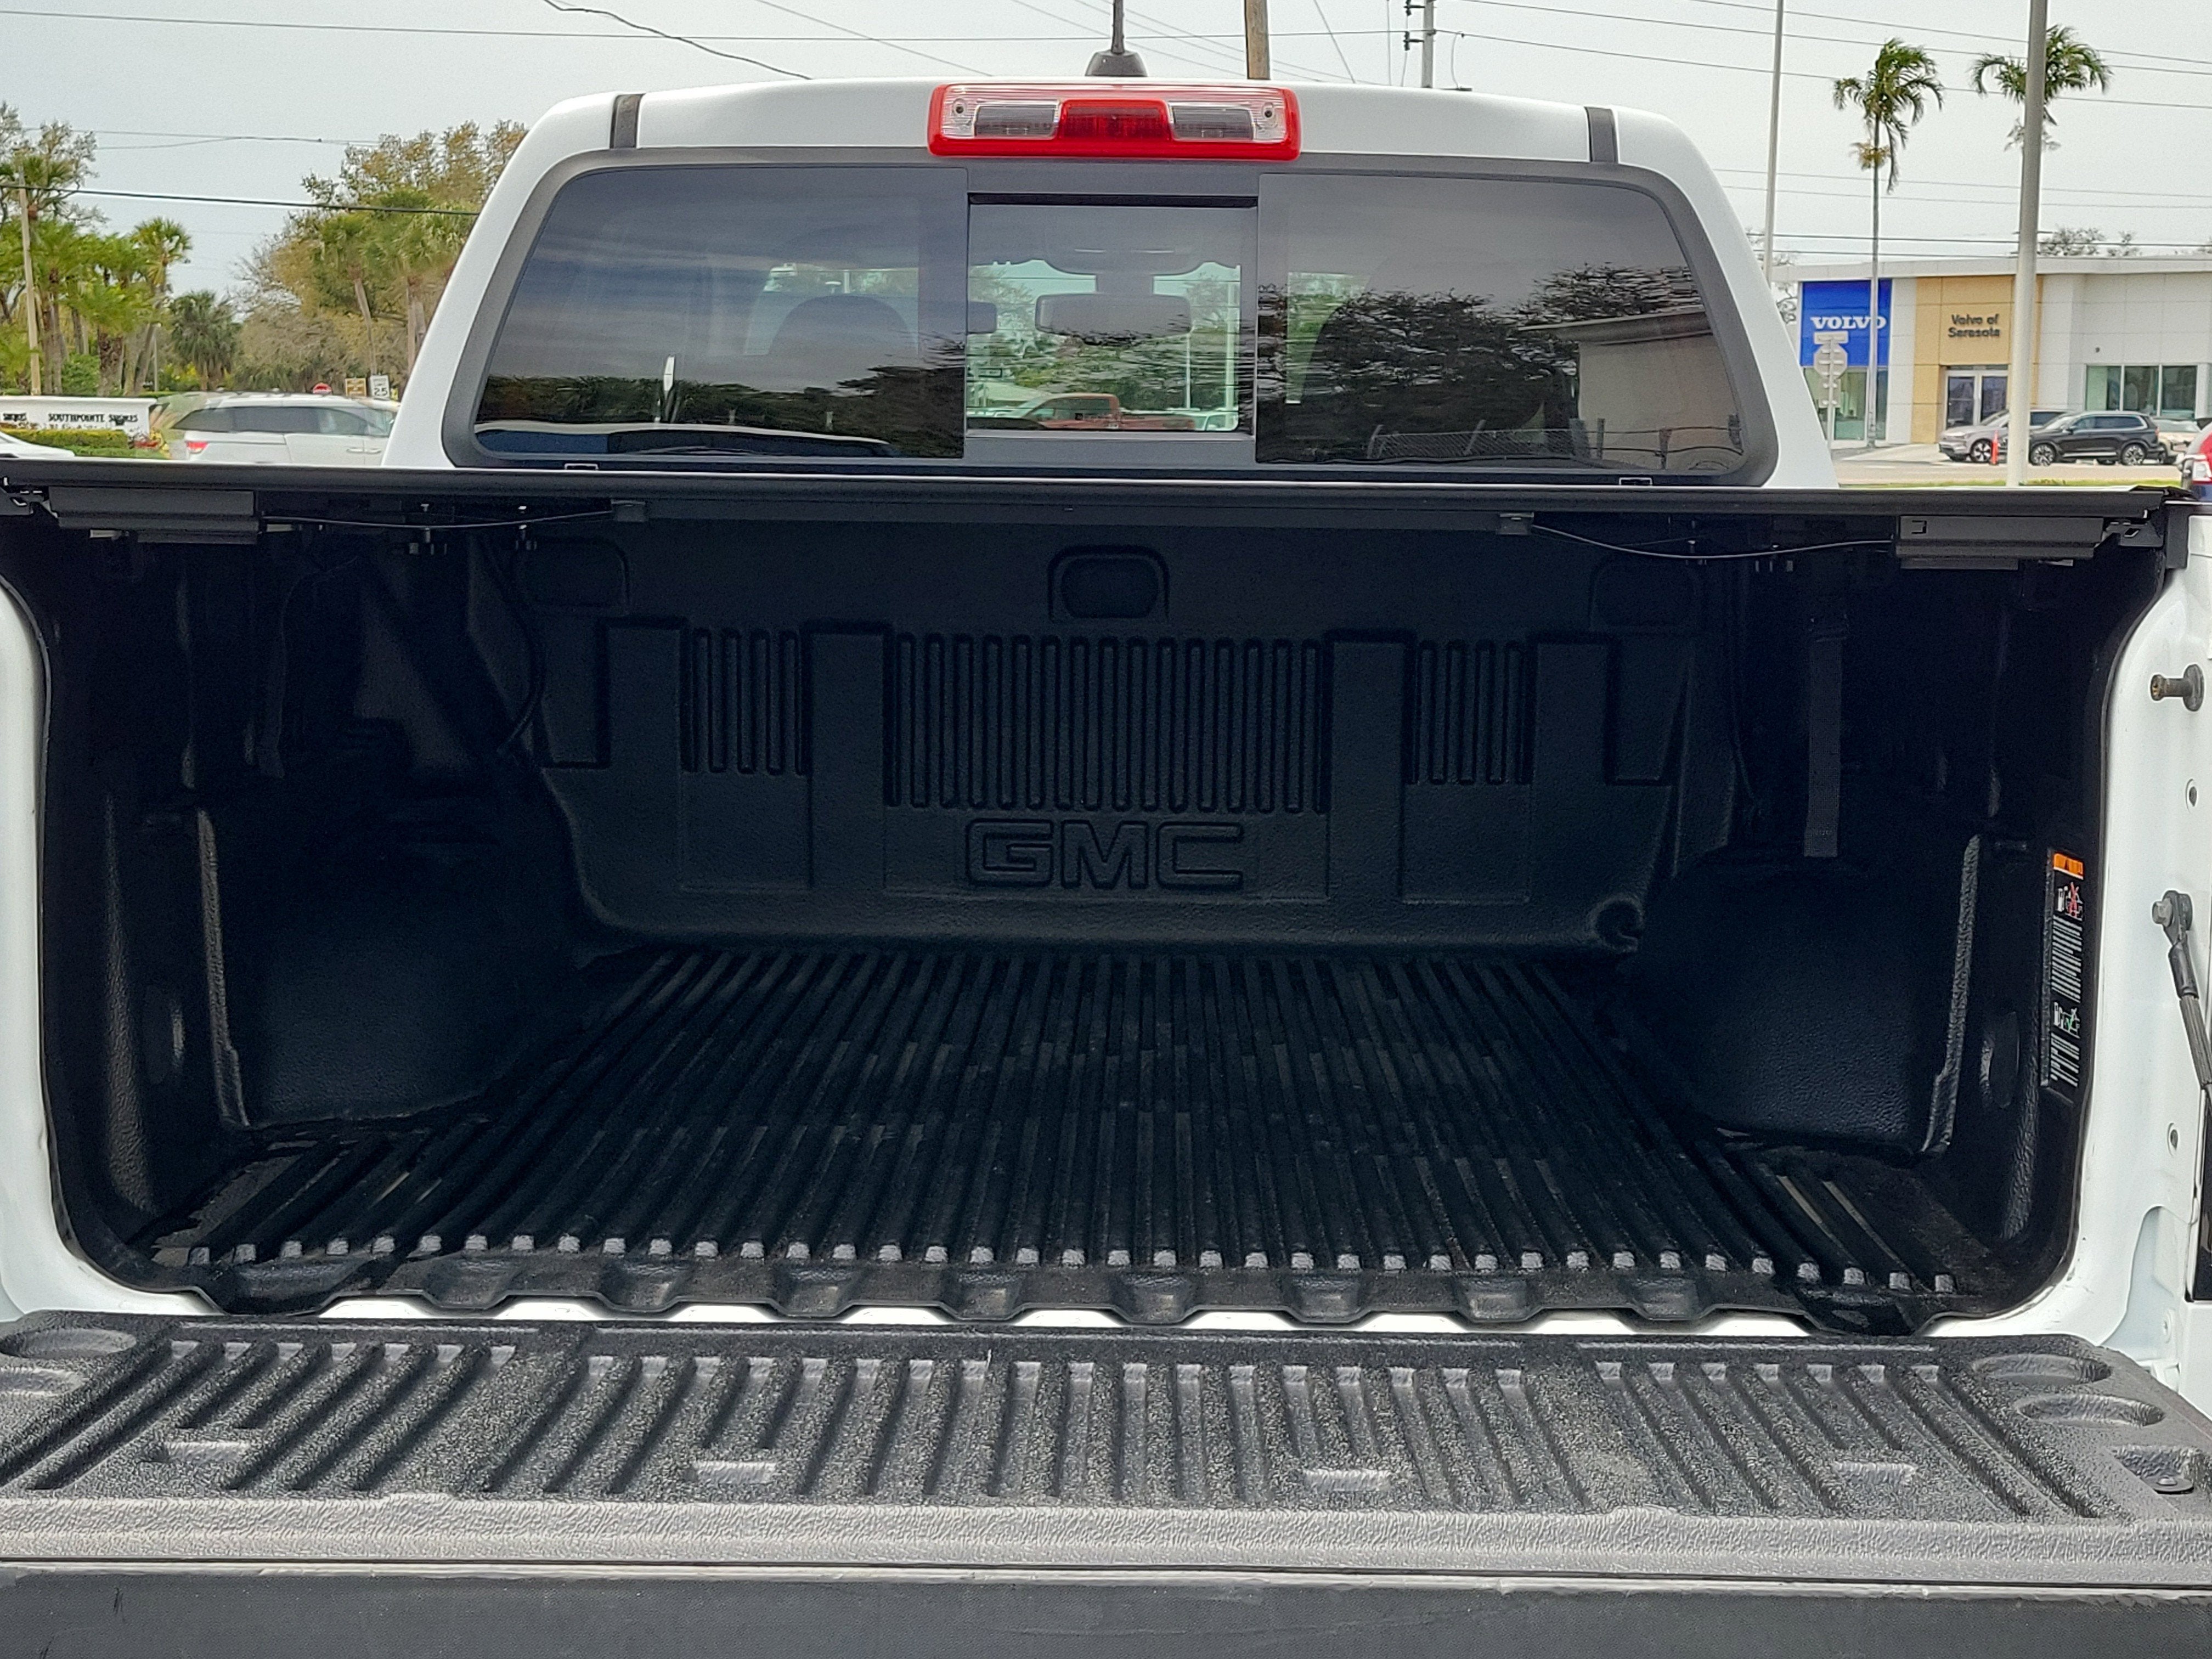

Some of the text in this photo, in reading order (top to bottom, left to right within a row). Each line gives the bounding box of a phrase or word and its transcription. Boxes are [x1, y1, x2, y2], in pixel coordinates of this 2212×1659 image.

[1810, 316, 1887, 329] VOLVO
[1951, 313, 1999, 325] Volvo of
[374, 387, 387, 396] 25
[966, 818, 1244, 889] GMC
